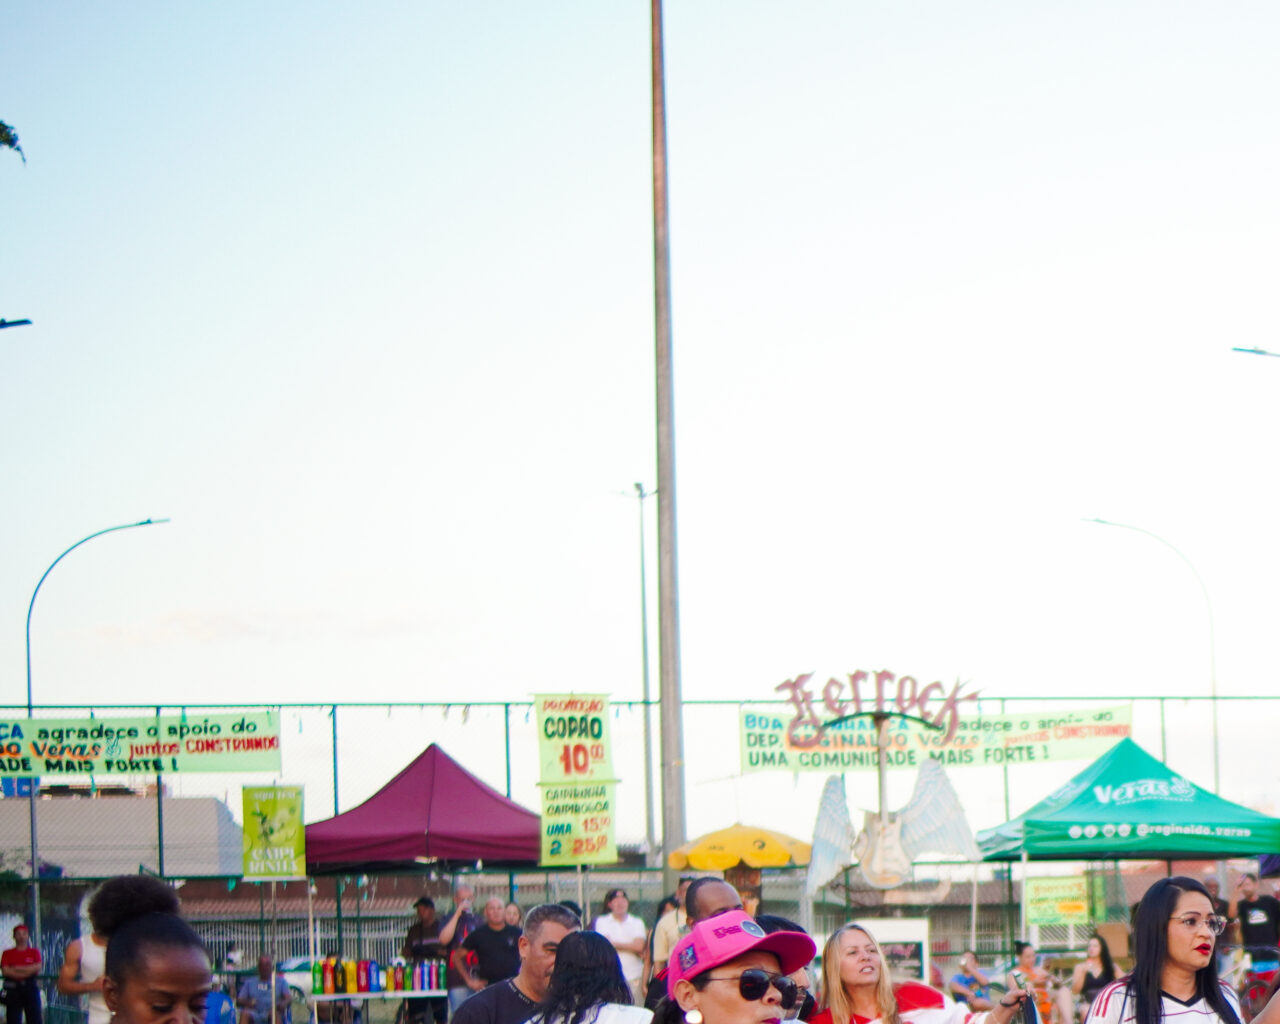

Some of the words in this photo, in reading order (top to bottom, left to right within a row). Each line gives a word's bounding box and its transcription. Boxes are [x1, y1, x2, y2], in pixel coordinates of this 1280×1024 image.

[38, 723, 139, 743] agradece
[147, 726, 158, 738] o
[168, 718, 222, 740] apoio
[232, 716, 257, 734] do
[544, 714, 603, 739] COPÃO
[745, 713, 784, 730] BOA
[129, 741, 180, 761] juntos
[186, 735, 280, 754] CONSTRUINDO
[748, 751, 789, 766] UMA
[929, 748, 974, 764] MAIS
[984, 746, 1036, 763] FORTE
[45, 758, 95, 773] MAIS
[105, 757, 164, 773] FORTE
